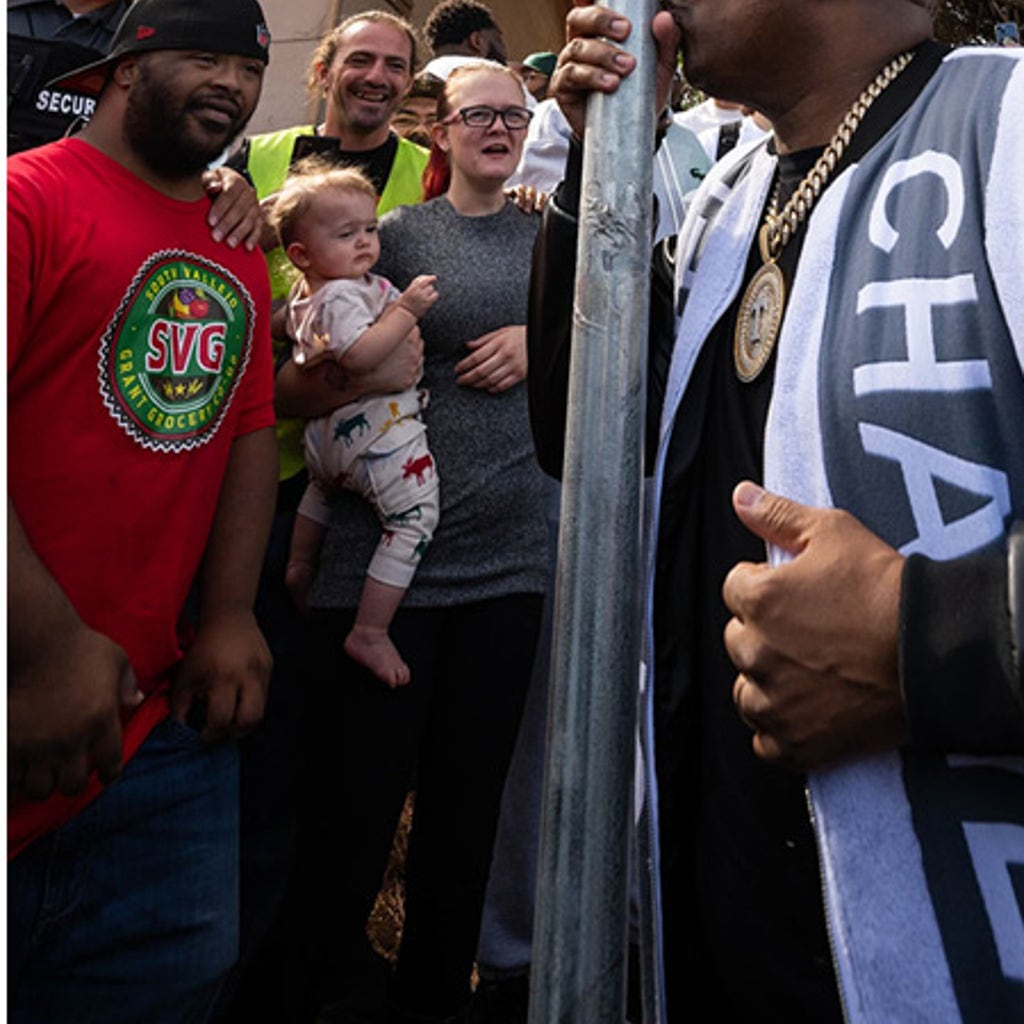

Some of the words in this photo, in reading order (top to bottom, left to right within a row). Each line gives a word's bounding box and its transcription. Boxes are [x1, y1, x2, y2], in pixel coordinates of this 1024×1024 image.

[182, 265, 238, 309] VALLEJO
[145, 318, 226, 376] SVG
[119, 348, 148, 408] GRANT
